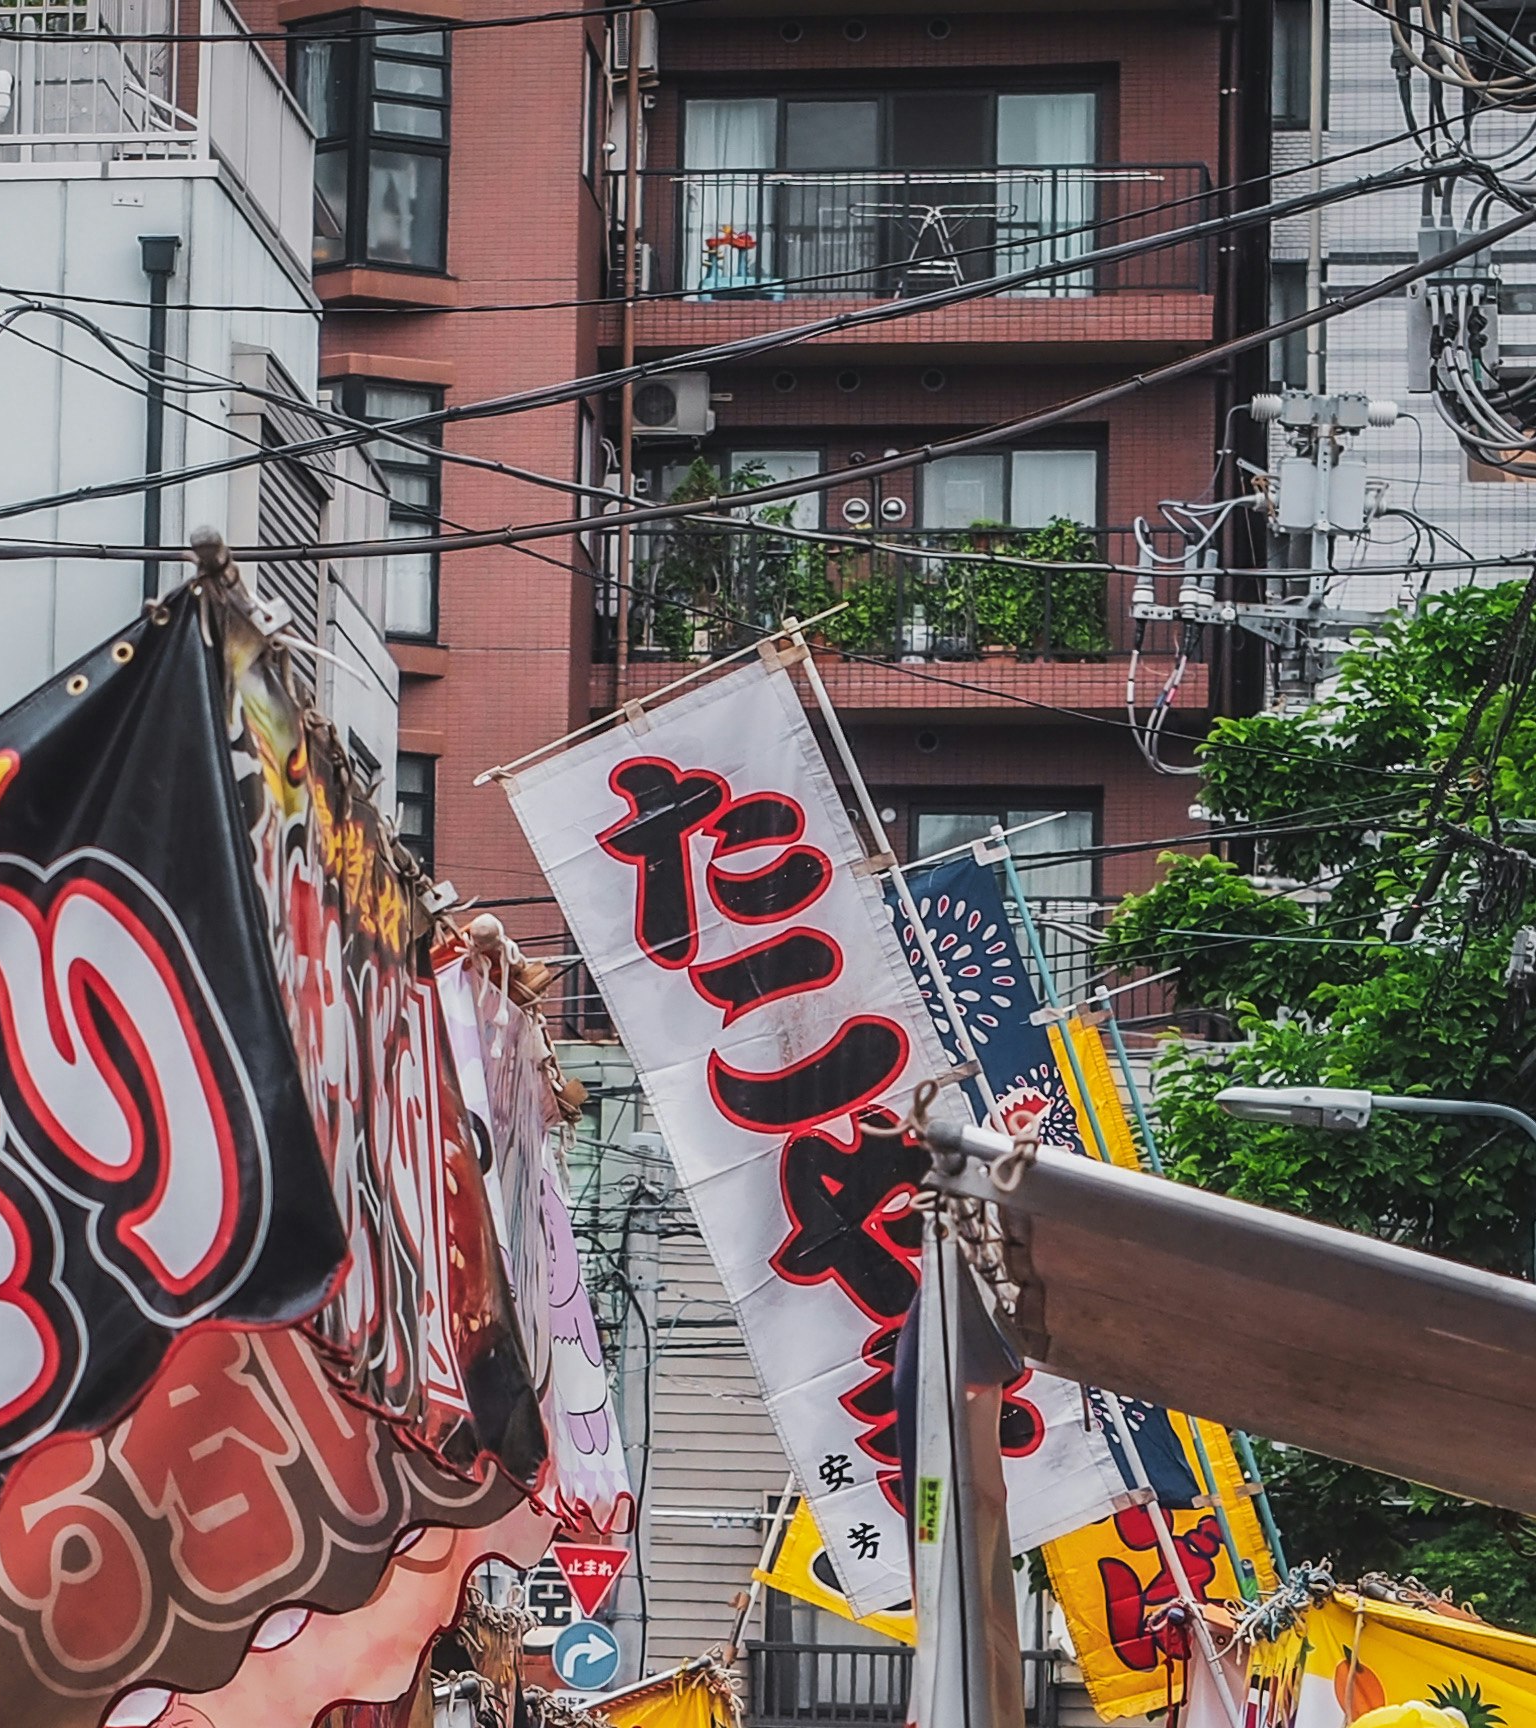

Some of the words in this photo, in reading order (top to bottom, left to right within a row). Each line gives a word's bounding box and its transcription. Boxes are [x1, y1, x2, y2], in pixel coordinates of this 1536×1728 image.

[818, 1452, 882, 1562] 安芳
[566, 1558, 614, 1578] 止まれ
